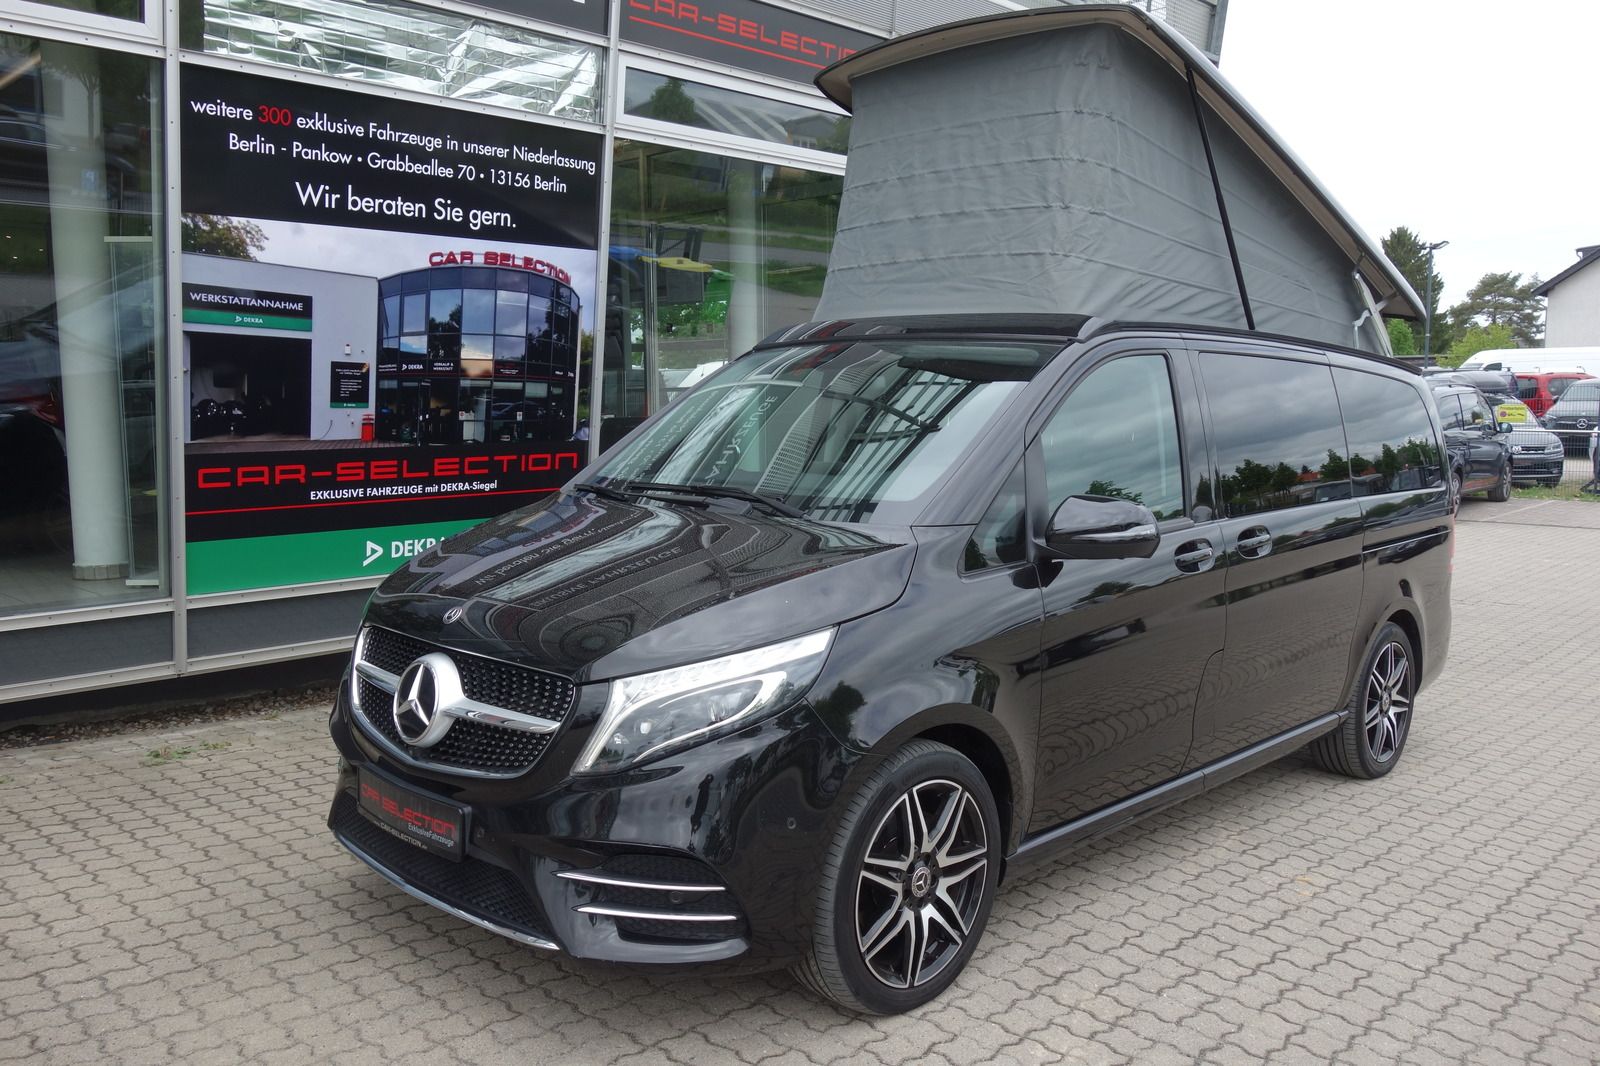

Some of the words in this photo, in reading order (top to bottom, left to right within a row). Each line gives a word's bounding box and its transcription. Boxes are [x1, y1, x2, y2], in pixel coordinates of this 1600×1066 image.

[190, 99, 253, 121] weitere
[258, 105, 292, 127] 300
[296, 111, 365, 137] exklusive
[369, 122, 443, 152] Fahrzeuge
[446, 134, 459, 151] in
[463, 142, 510, 159] unserer
[513, 145, 596, 176] Niederlassung
[229, 132, 275, 155] Berlin
[292, 141, 353, 165] Pankow
[367, 152, 454, 178] Grabbeallee
[457, 164, 476, 181] 70
[489, 168, 531, 189] 13156
[534, 174, 568, 193] Berlin
[295, 181, 340, 209] Wir
[347, 184, 427, 218] beraten
[433, 197, 464, 222] Sie
[469, 208, 517, 230] gern.
[428, 250, 474, 267] CAR
[483, 251, 572, 285] SELECTION
[189, 291, 304, 311] WERKSTATTANNAHME
[243, 316, 264, 324] DEKRA
[197, 452, 579, 489] CAR-SELECTION
[310, 488, 365, 501] EXKLUSIVE
[366, 484, 423, 497] FAHRZEUGE
[424, 482, 439, 494] mit
[440, 479, 498, 492] DEKRA-Siegel
[391, 536, 445, 559] DEKR
